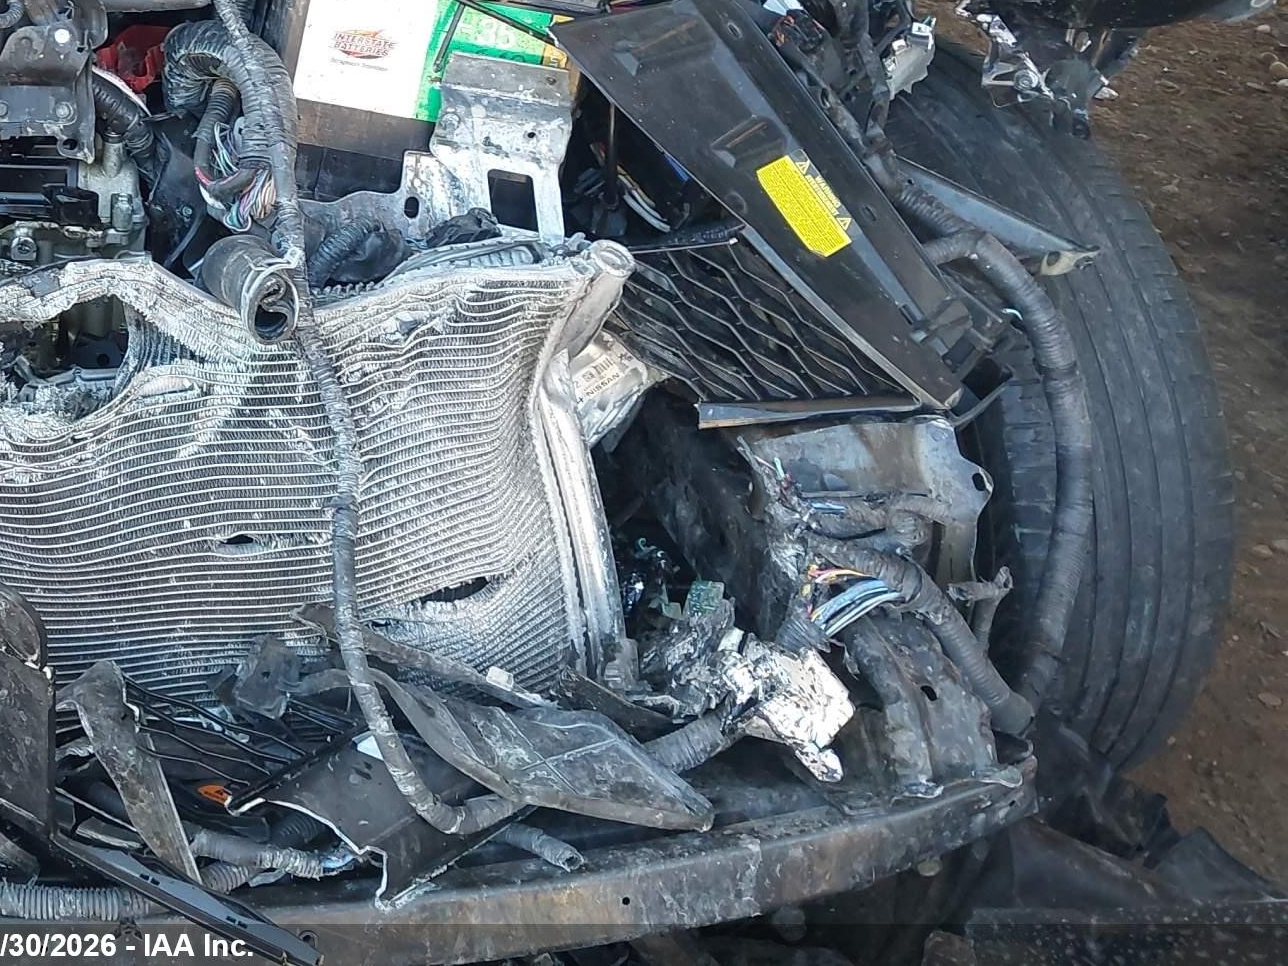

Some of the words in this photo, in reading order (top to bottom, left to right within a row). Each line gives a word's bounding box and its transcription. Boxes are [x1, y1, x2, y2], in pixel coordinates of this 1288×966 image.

[334, 33, 393, 49] INTERSTATE
[334, 41, 389, 57] BATTERIES
[586, 372, 620, 396] NISSAN
